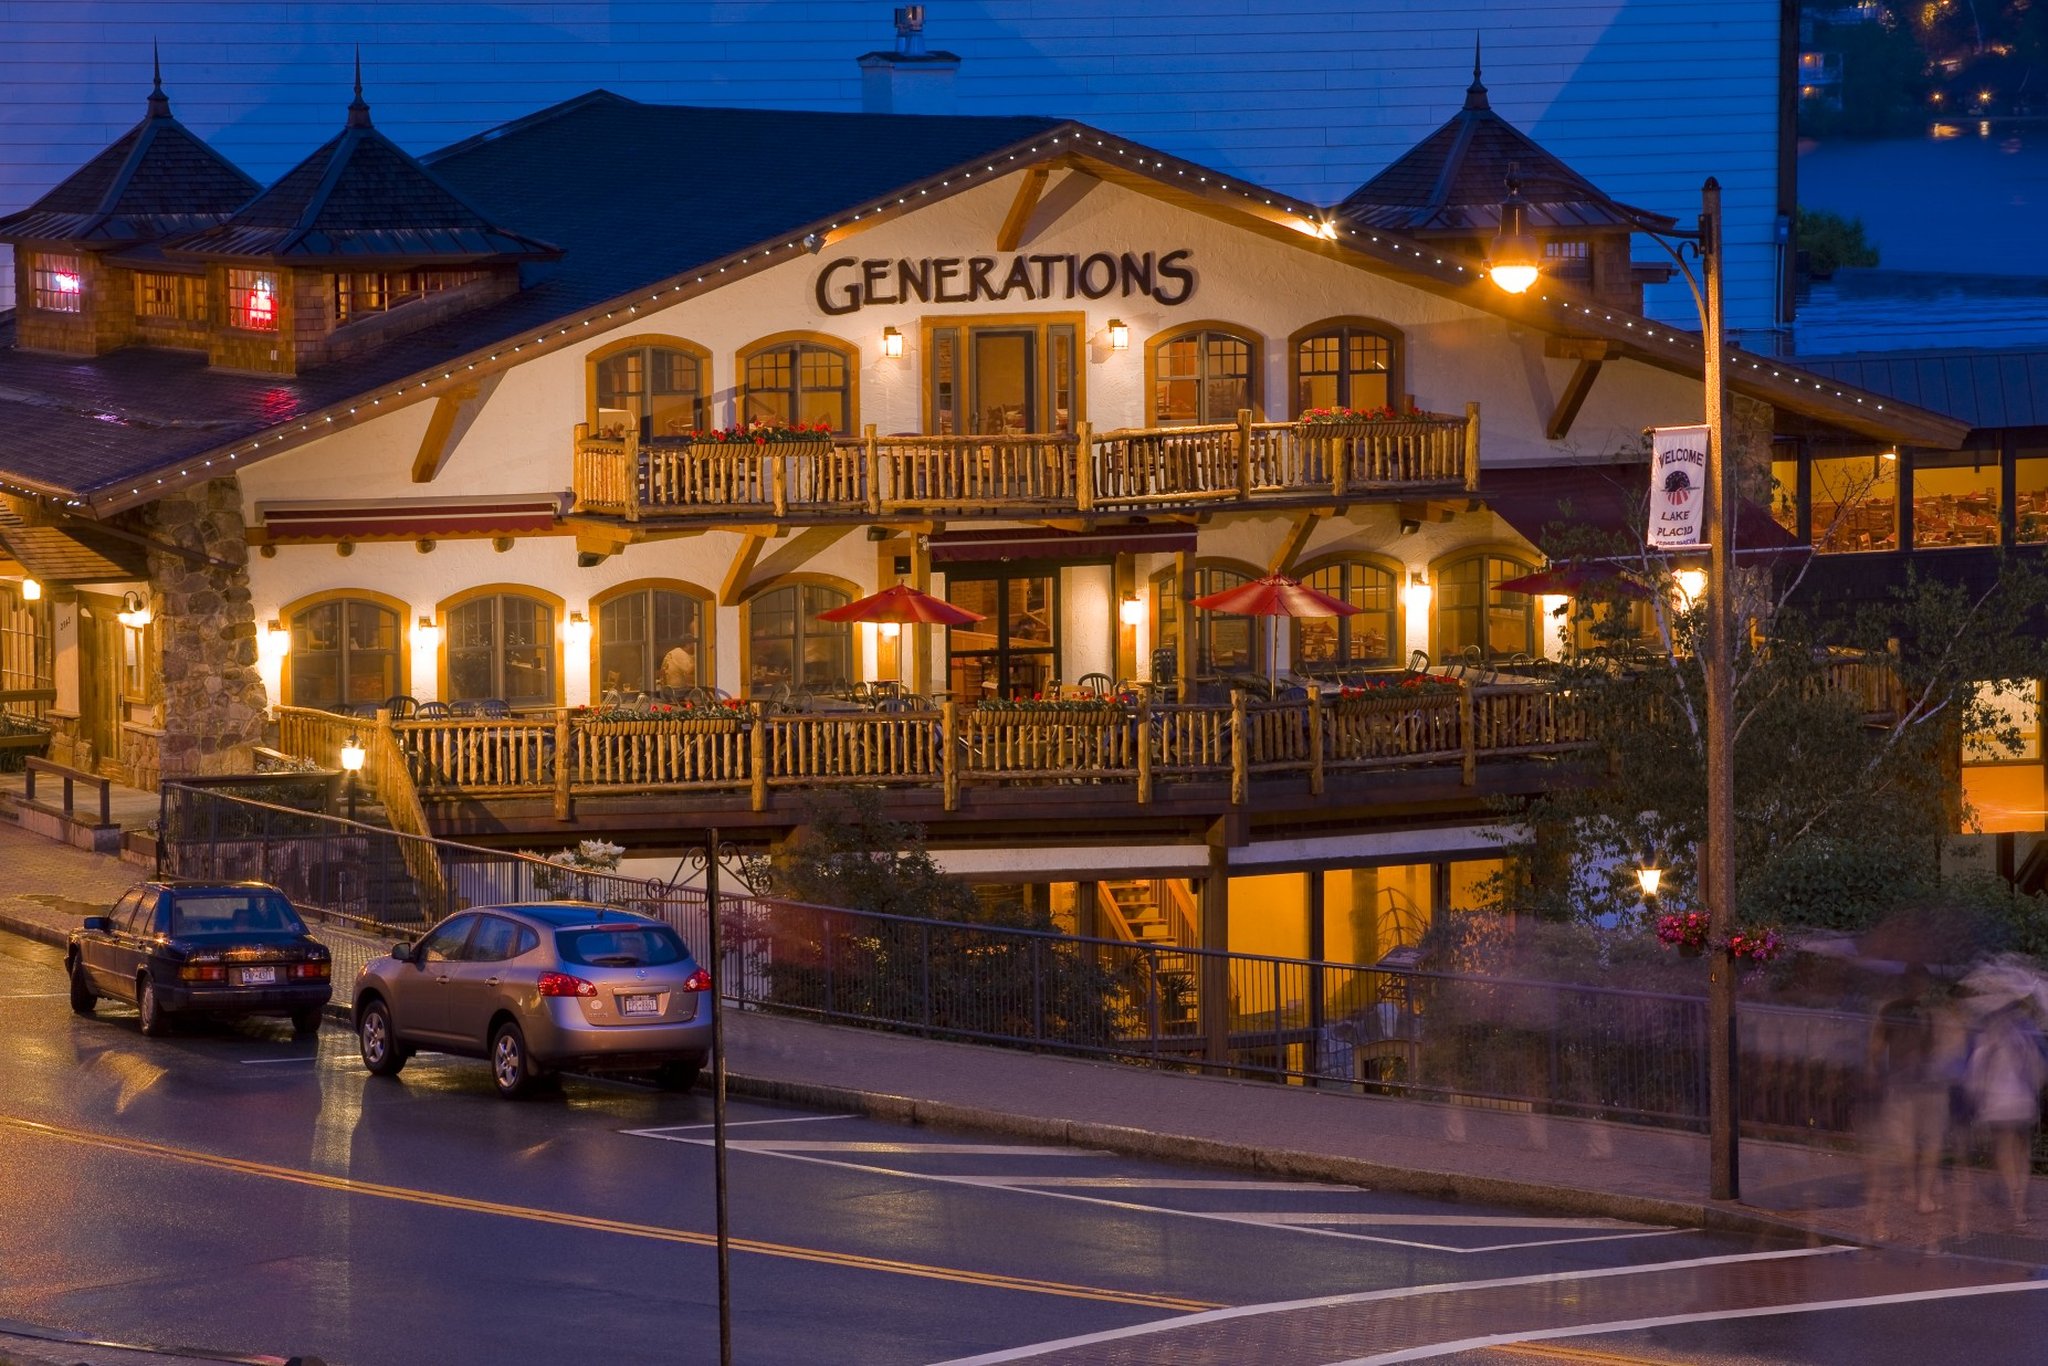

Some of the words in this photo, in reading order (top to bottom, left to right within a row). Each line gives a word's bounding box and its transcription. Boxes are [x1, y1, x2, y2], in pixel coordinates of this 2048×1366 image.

[815, 249, 1194, 316] GENERATIONS
[1661, 510, 1691, 521] LAKE
[1656, 525, 1693, 537] PLACID
